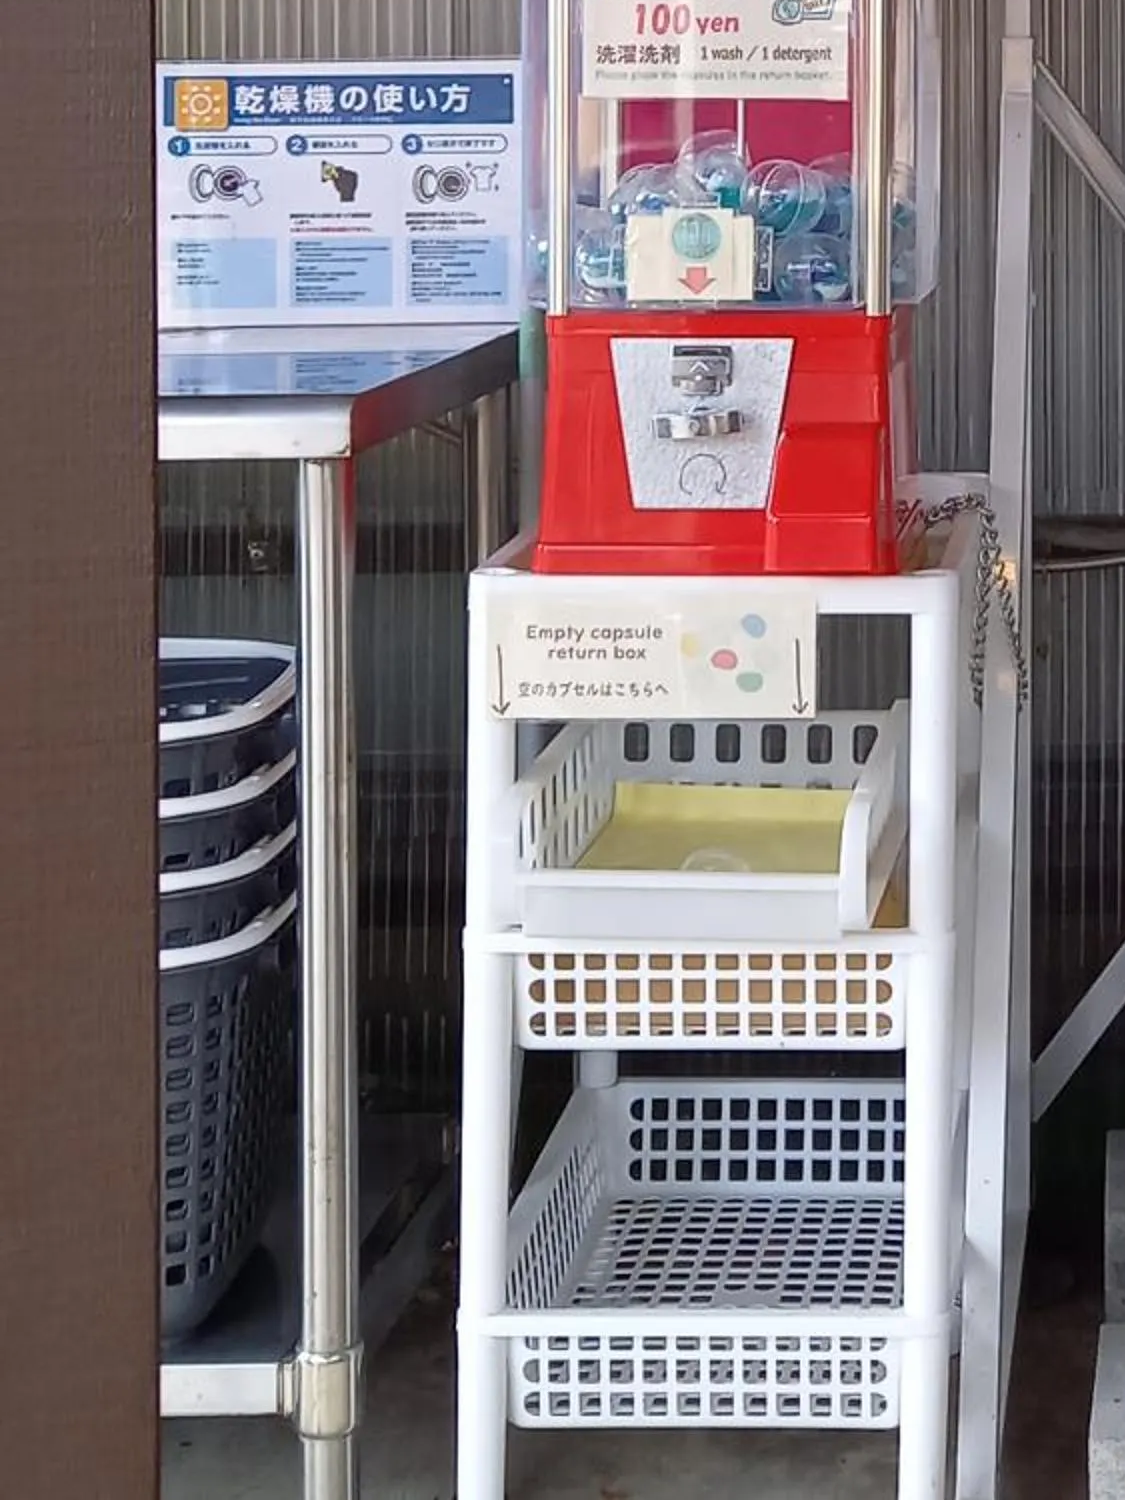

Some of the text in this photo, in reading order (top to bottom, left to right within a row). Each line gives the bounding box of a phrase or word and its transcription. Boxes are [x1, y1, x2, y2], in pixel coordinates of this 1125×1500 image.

[635, 3, 739, 36] 100 yen
[596, 45, 680, 65] 洗濯洗剤
[701, 46, 707, 60] 1
[711, 46, 743, 60] wash
[762, 46, 769, 60] 1
[772, 45, 832, 63] detergent
[235, 83, 471, 115] 乾燥機の使い方
[526, 625, 663, 641] Empty capsule
[549, 646, 647, 660] return box
[518, 682, 669, 698] 空のカプセルはこちらへ
